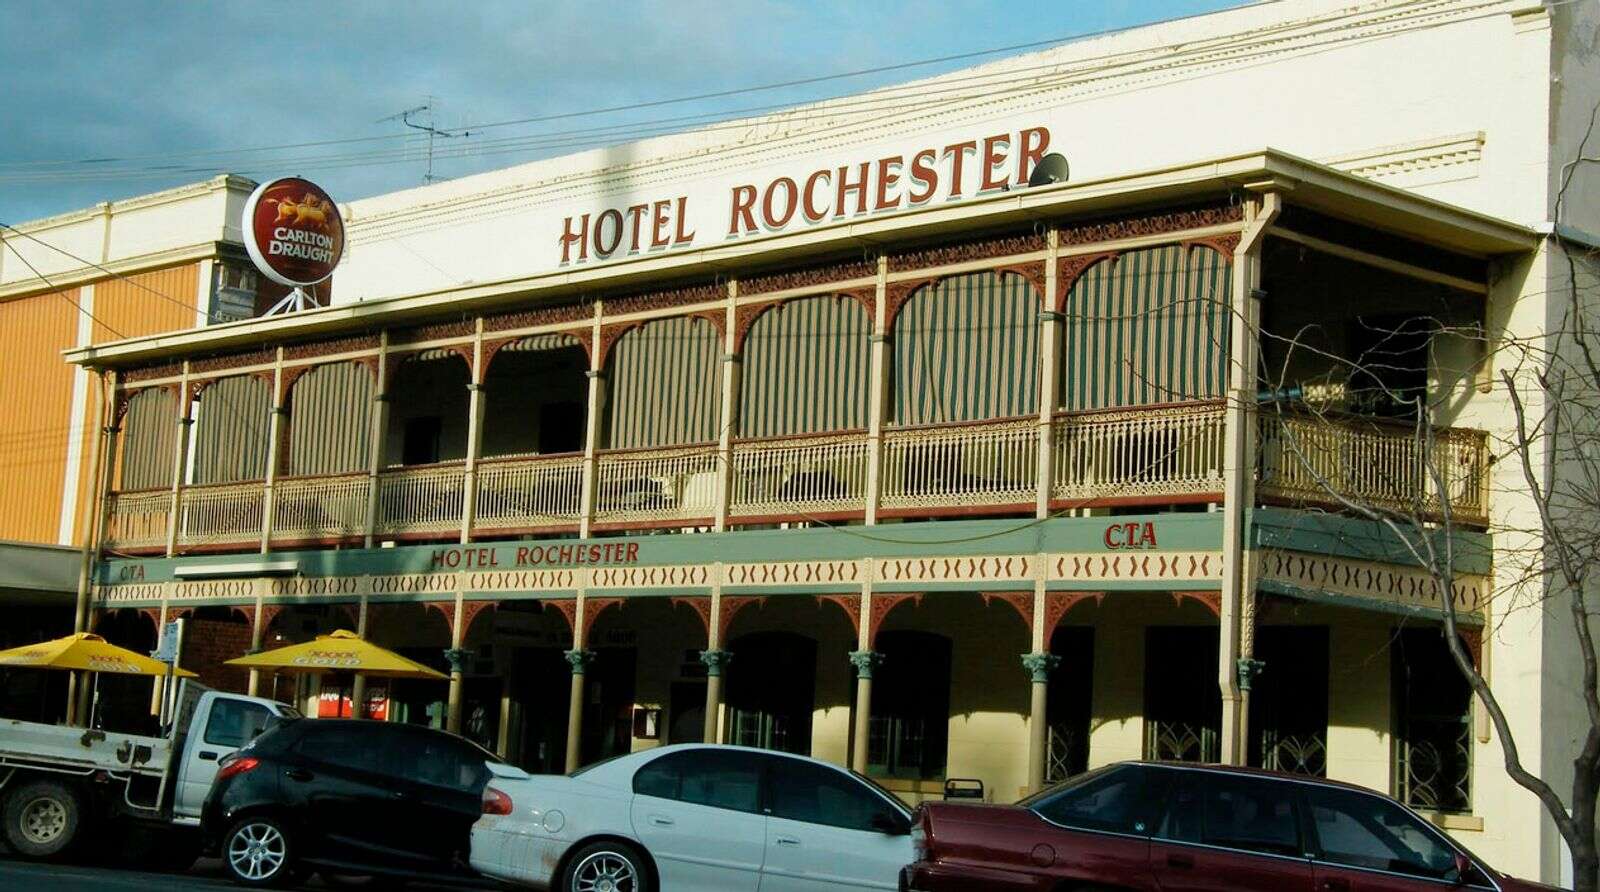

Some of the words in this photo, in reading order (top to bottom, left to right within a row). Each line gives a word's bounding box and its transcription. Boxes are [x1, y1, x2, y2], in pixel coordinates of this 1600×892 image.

[559, 196, 695, 264] HOTEL
[727, 126, 1051, 236] ROCHESTER
[273, 227, 333, 249] CARLTON
[268, 240, 333, 264] DRAUGHT
[431, 547, 499, 568] HOTEL
[516, 542, 640, 566] ROCHESTER
